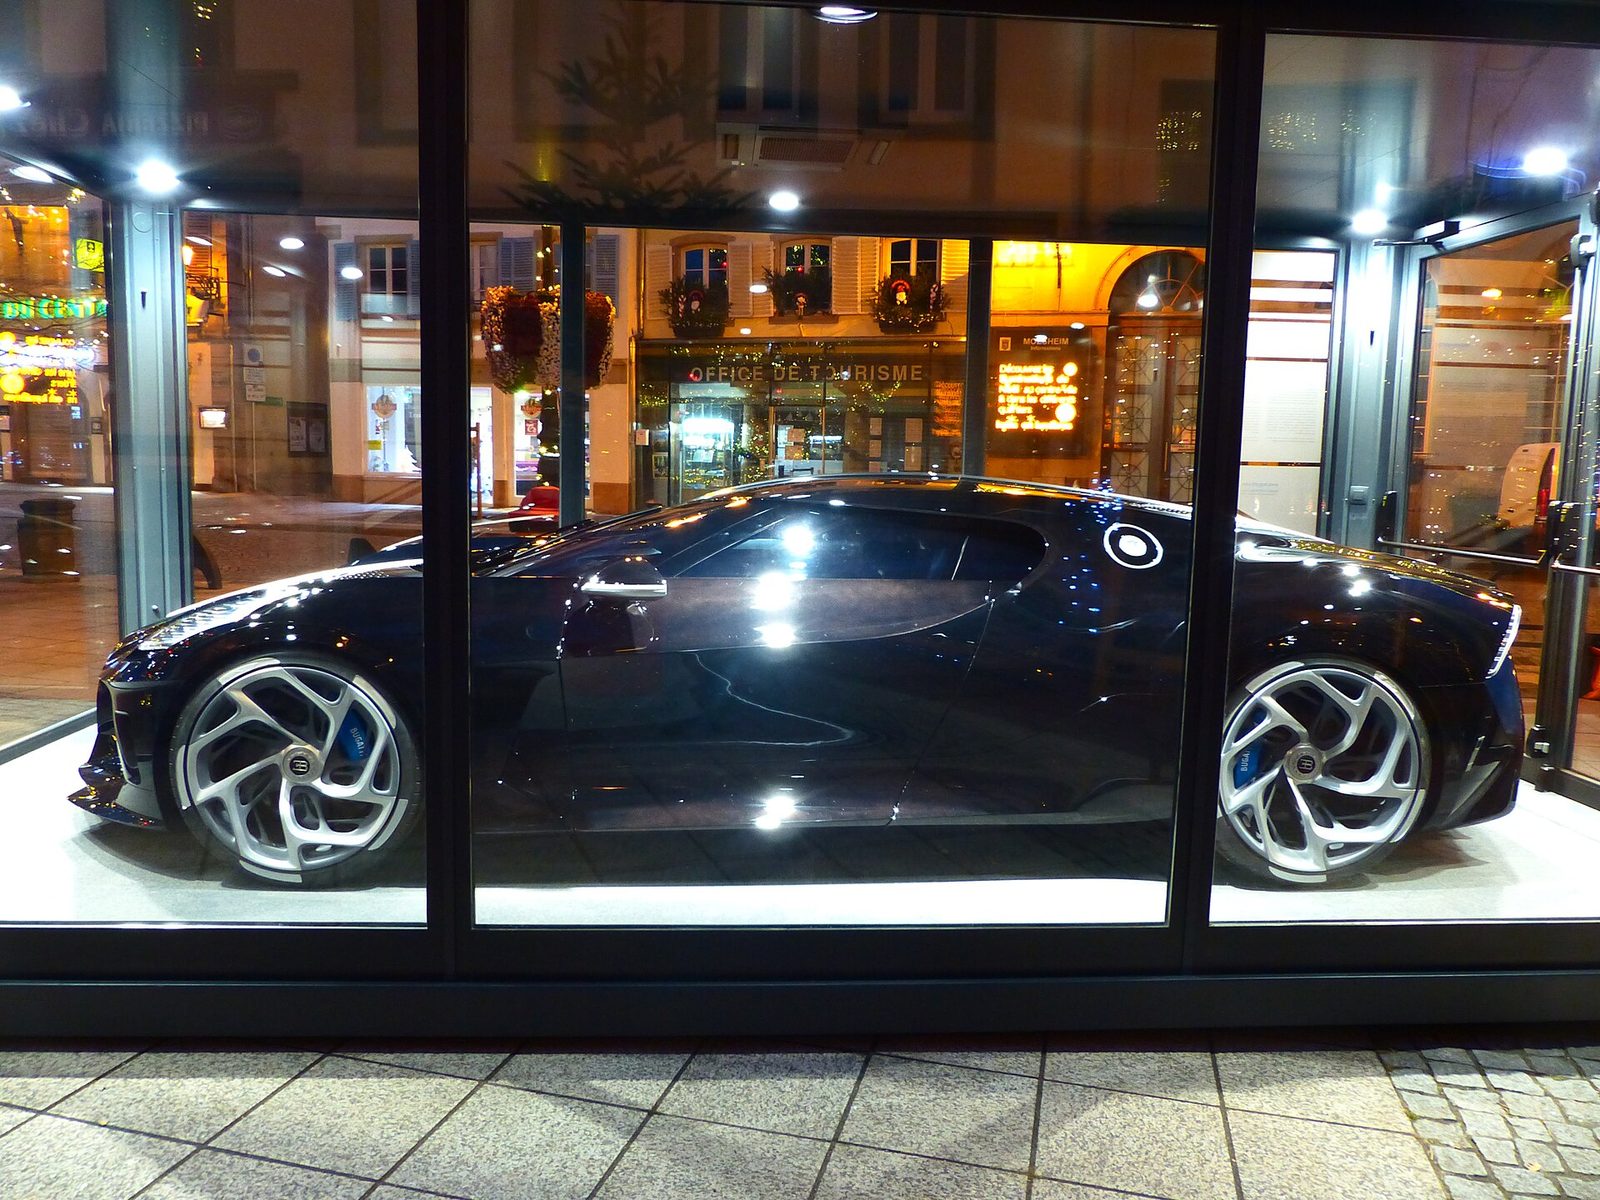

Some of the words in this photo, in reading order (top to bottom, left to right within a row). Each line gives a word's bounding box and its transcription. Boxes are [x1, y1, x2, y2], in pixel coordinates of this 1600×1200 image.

[1023, 337, 1069, 345] MOHEIM
[691, 366, 763, 381] OFFICE
[774, 366, 801, 381] DE
[810, 365, 922, 381] TOURISME
